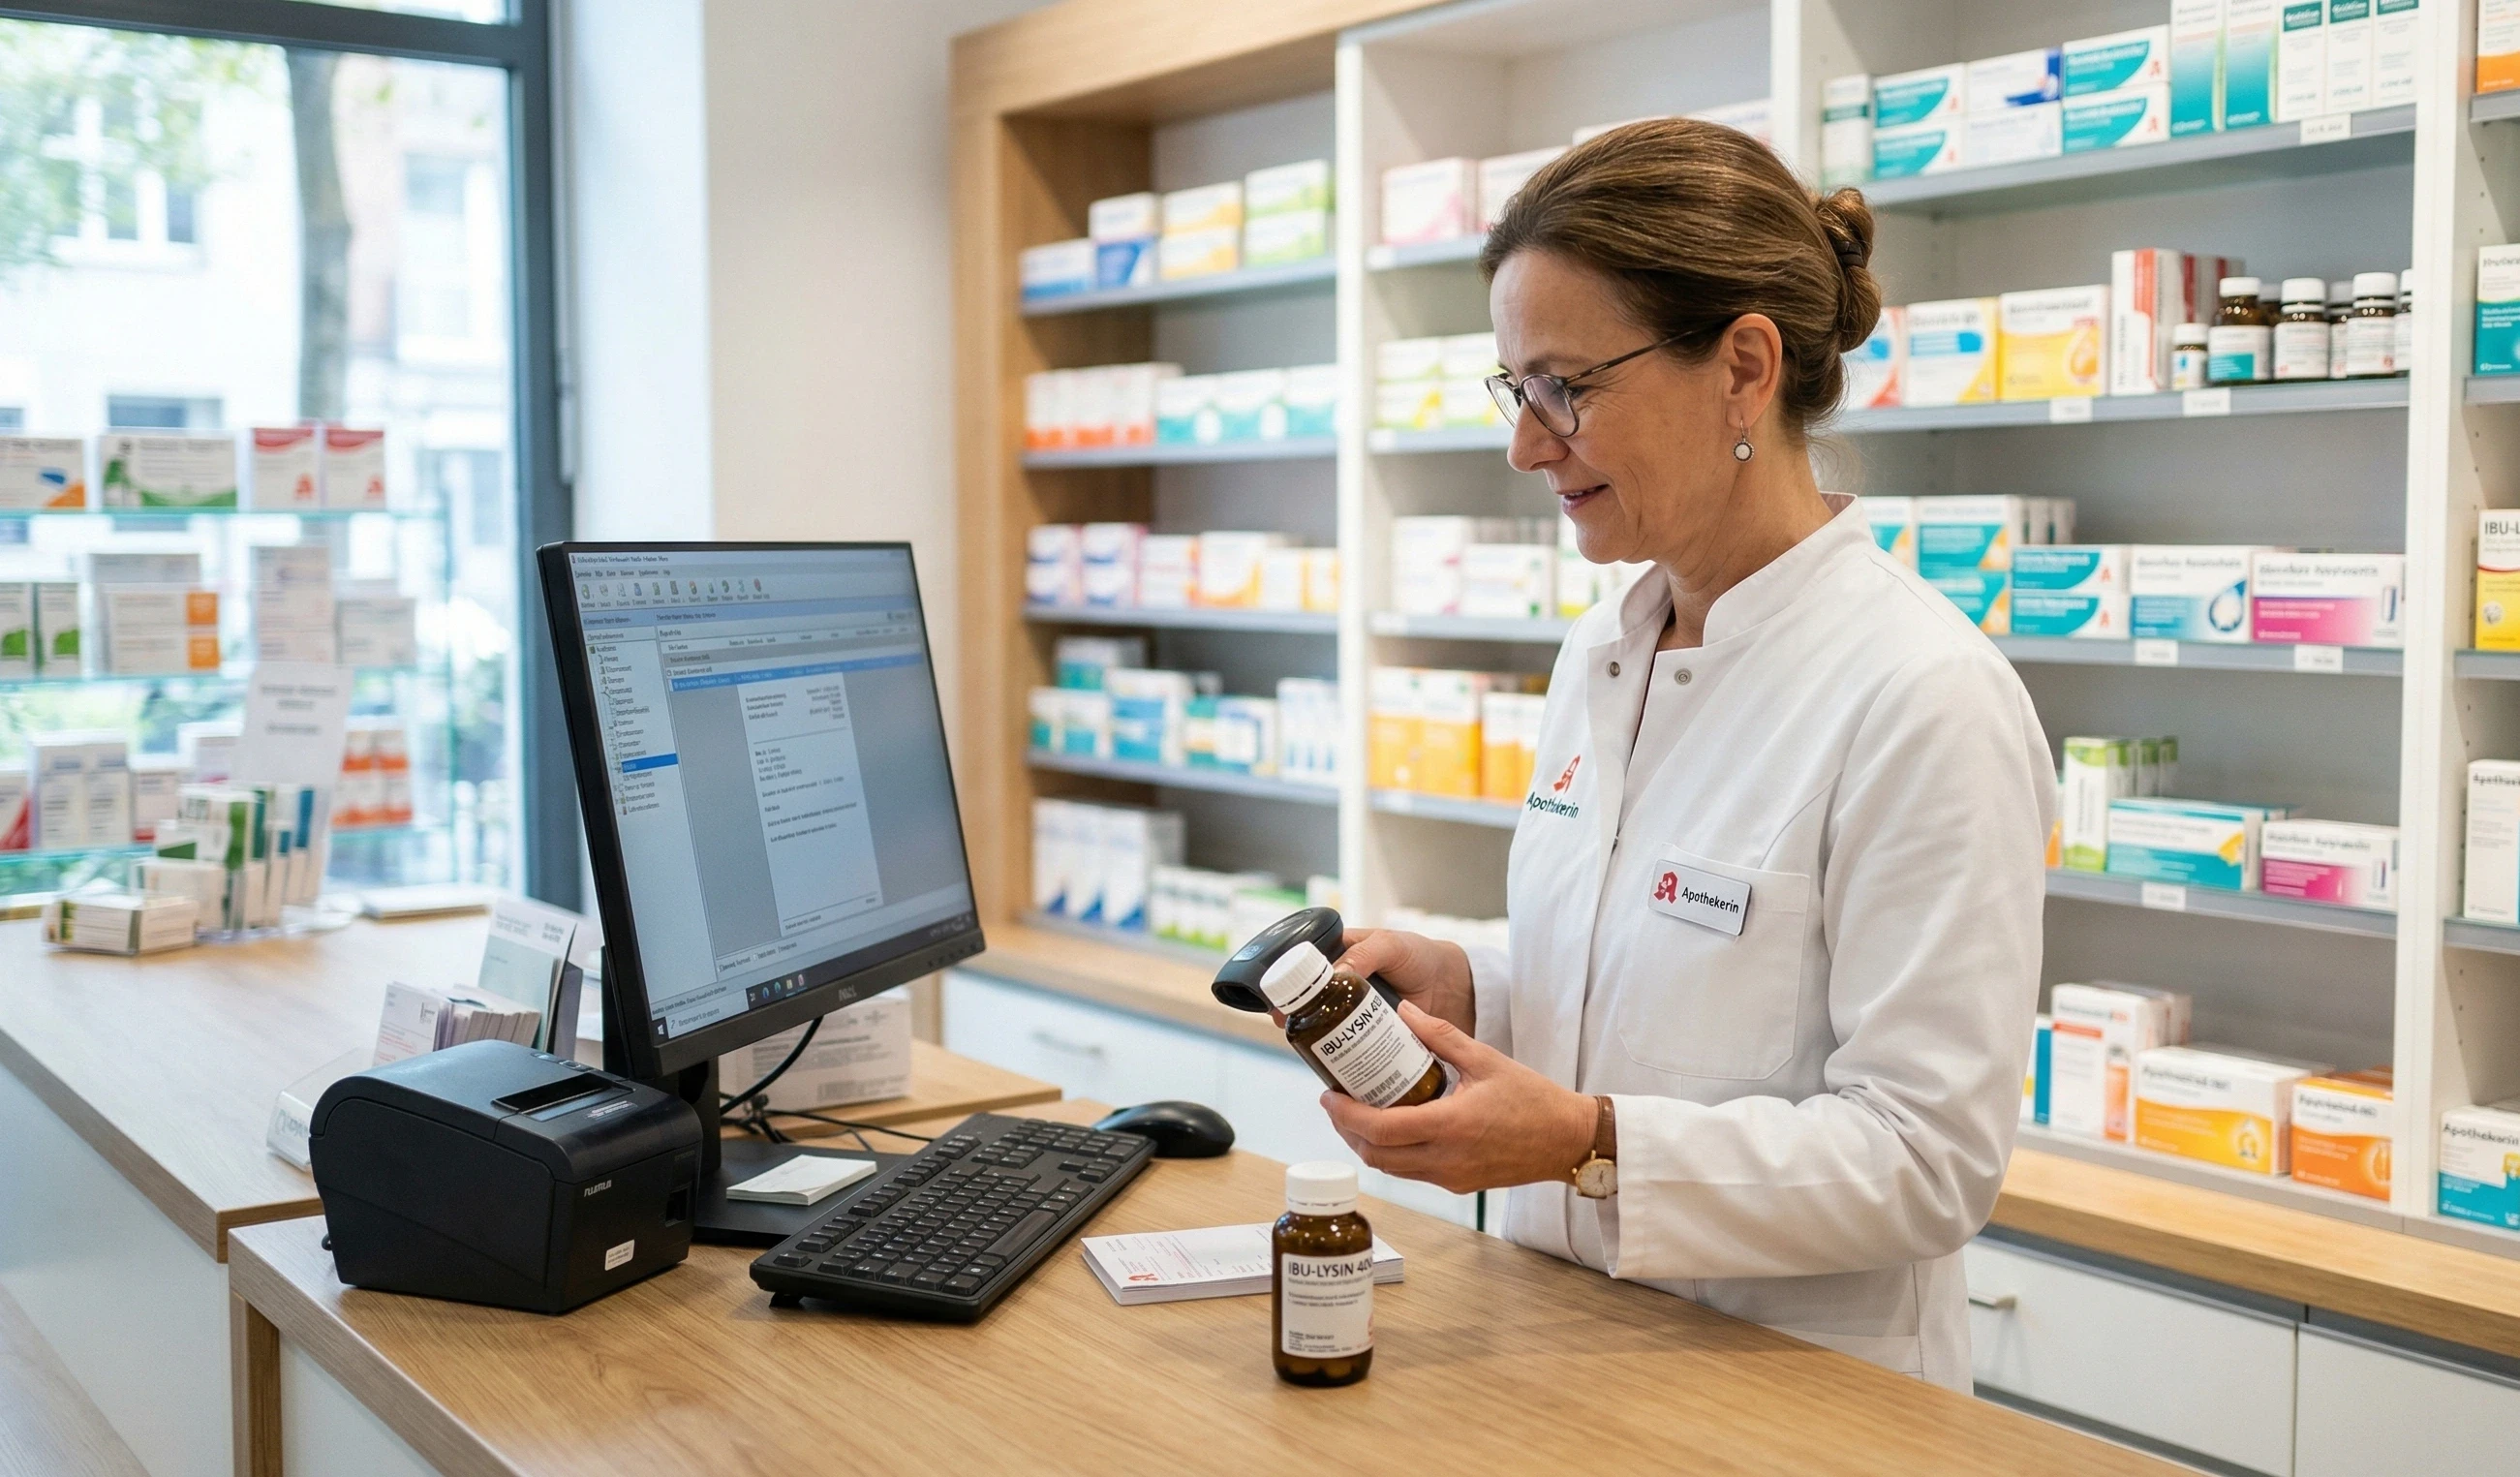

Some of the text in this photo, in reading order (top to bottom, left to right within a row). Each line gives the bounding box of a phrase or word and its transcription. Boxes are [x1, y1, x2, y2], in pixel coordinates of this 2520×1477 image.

[1681, 886, 1739, 913] Apothekerin
[1320, 1008, 1373, 1057] IBU-LYSIN
[1288, 1261, 1354, 1277] IBU-LYSIN
